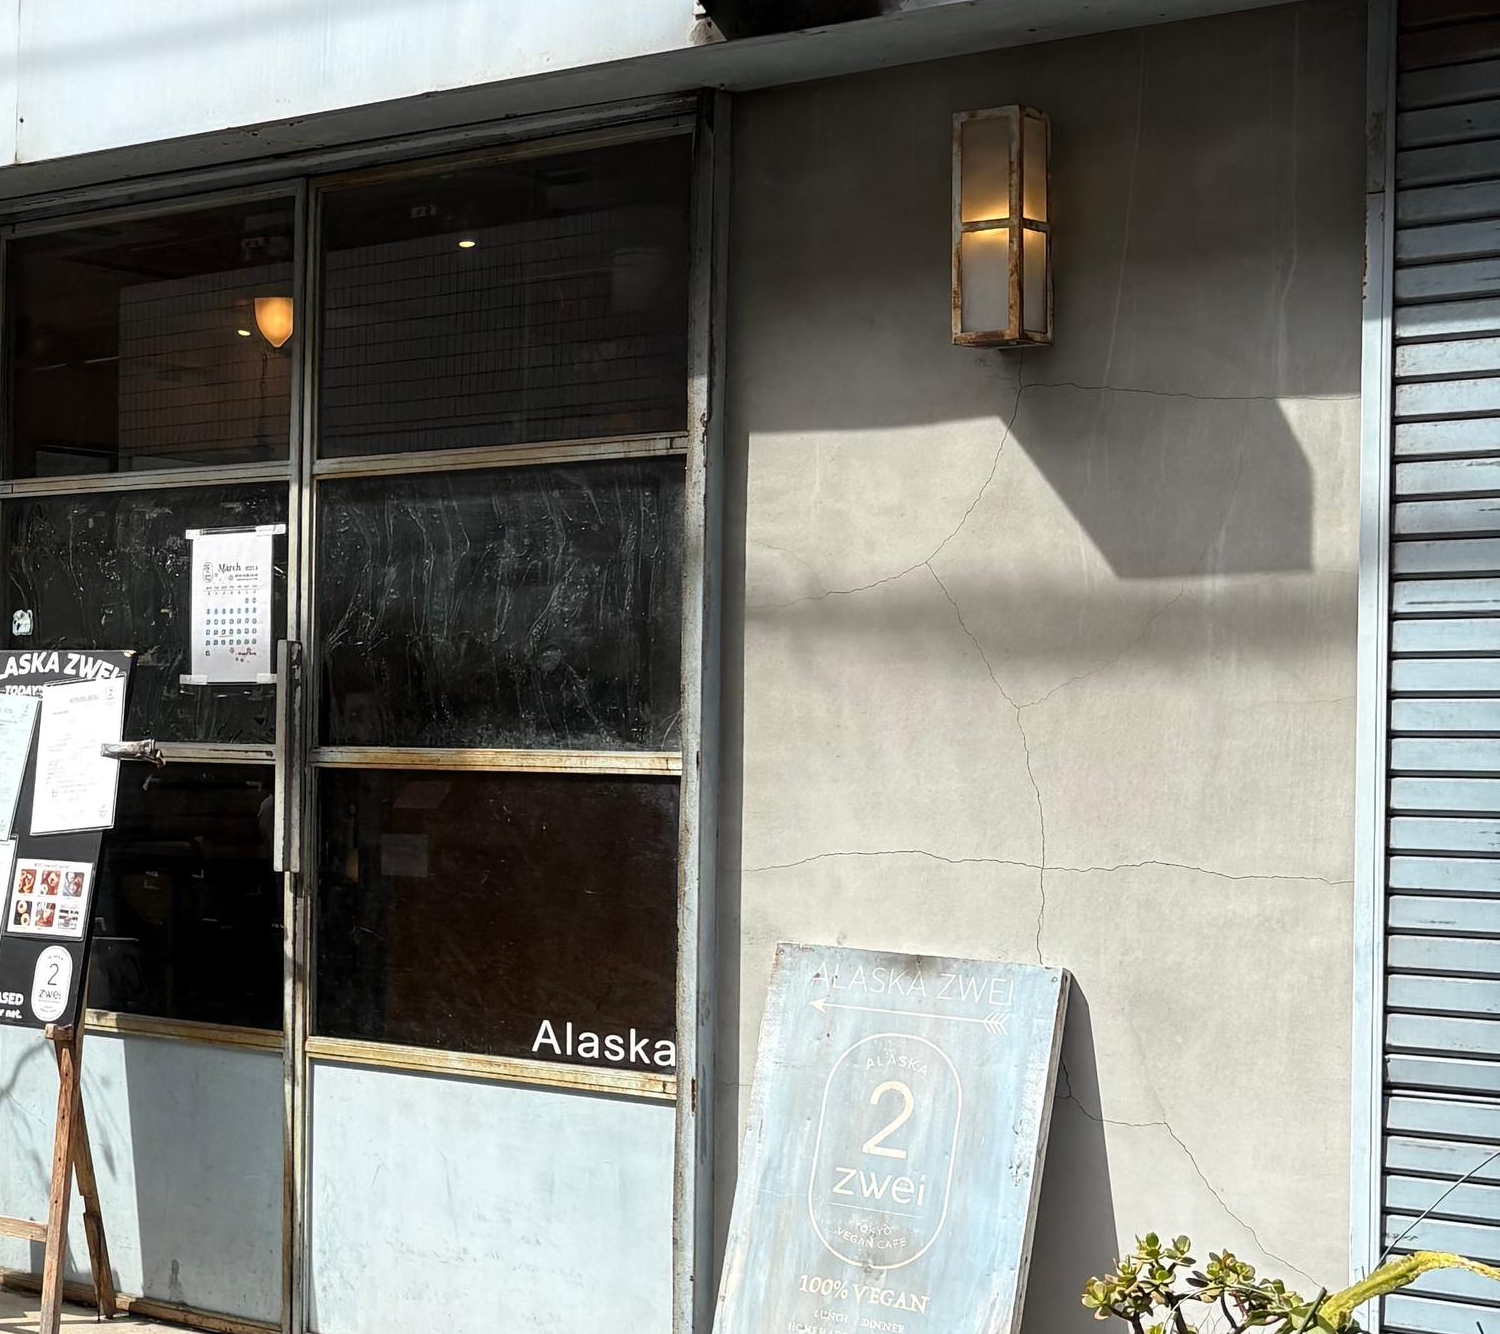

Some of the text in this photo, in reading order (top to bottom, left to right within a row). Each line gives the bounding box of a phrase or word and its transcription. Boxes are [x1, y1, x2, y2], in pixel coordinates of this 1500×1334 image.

[218, 562, 241, 574] March
[48, 963, 59, 985] 2
[810, 962, 1014, 1006] ALASKA ZWEI
[39, 989, 61, 1000] zwei
[531, 1019, 676, 1067] Alaska
[866, 1052, 928, 1075] ALASKA
[862, 1080, 914, 1159] 2
[832, 1166, 927, 1206] zwei
[837, 1227, 907, 1249] VEGAN CAFE
[856, 1222, 892, 1236] TOKYO
[798, 1274, 931, 1314] 100% VEGAN
[814, 1309, 848, 1324] LUNCH
[861, 1318, 905, 1334] DINNER
